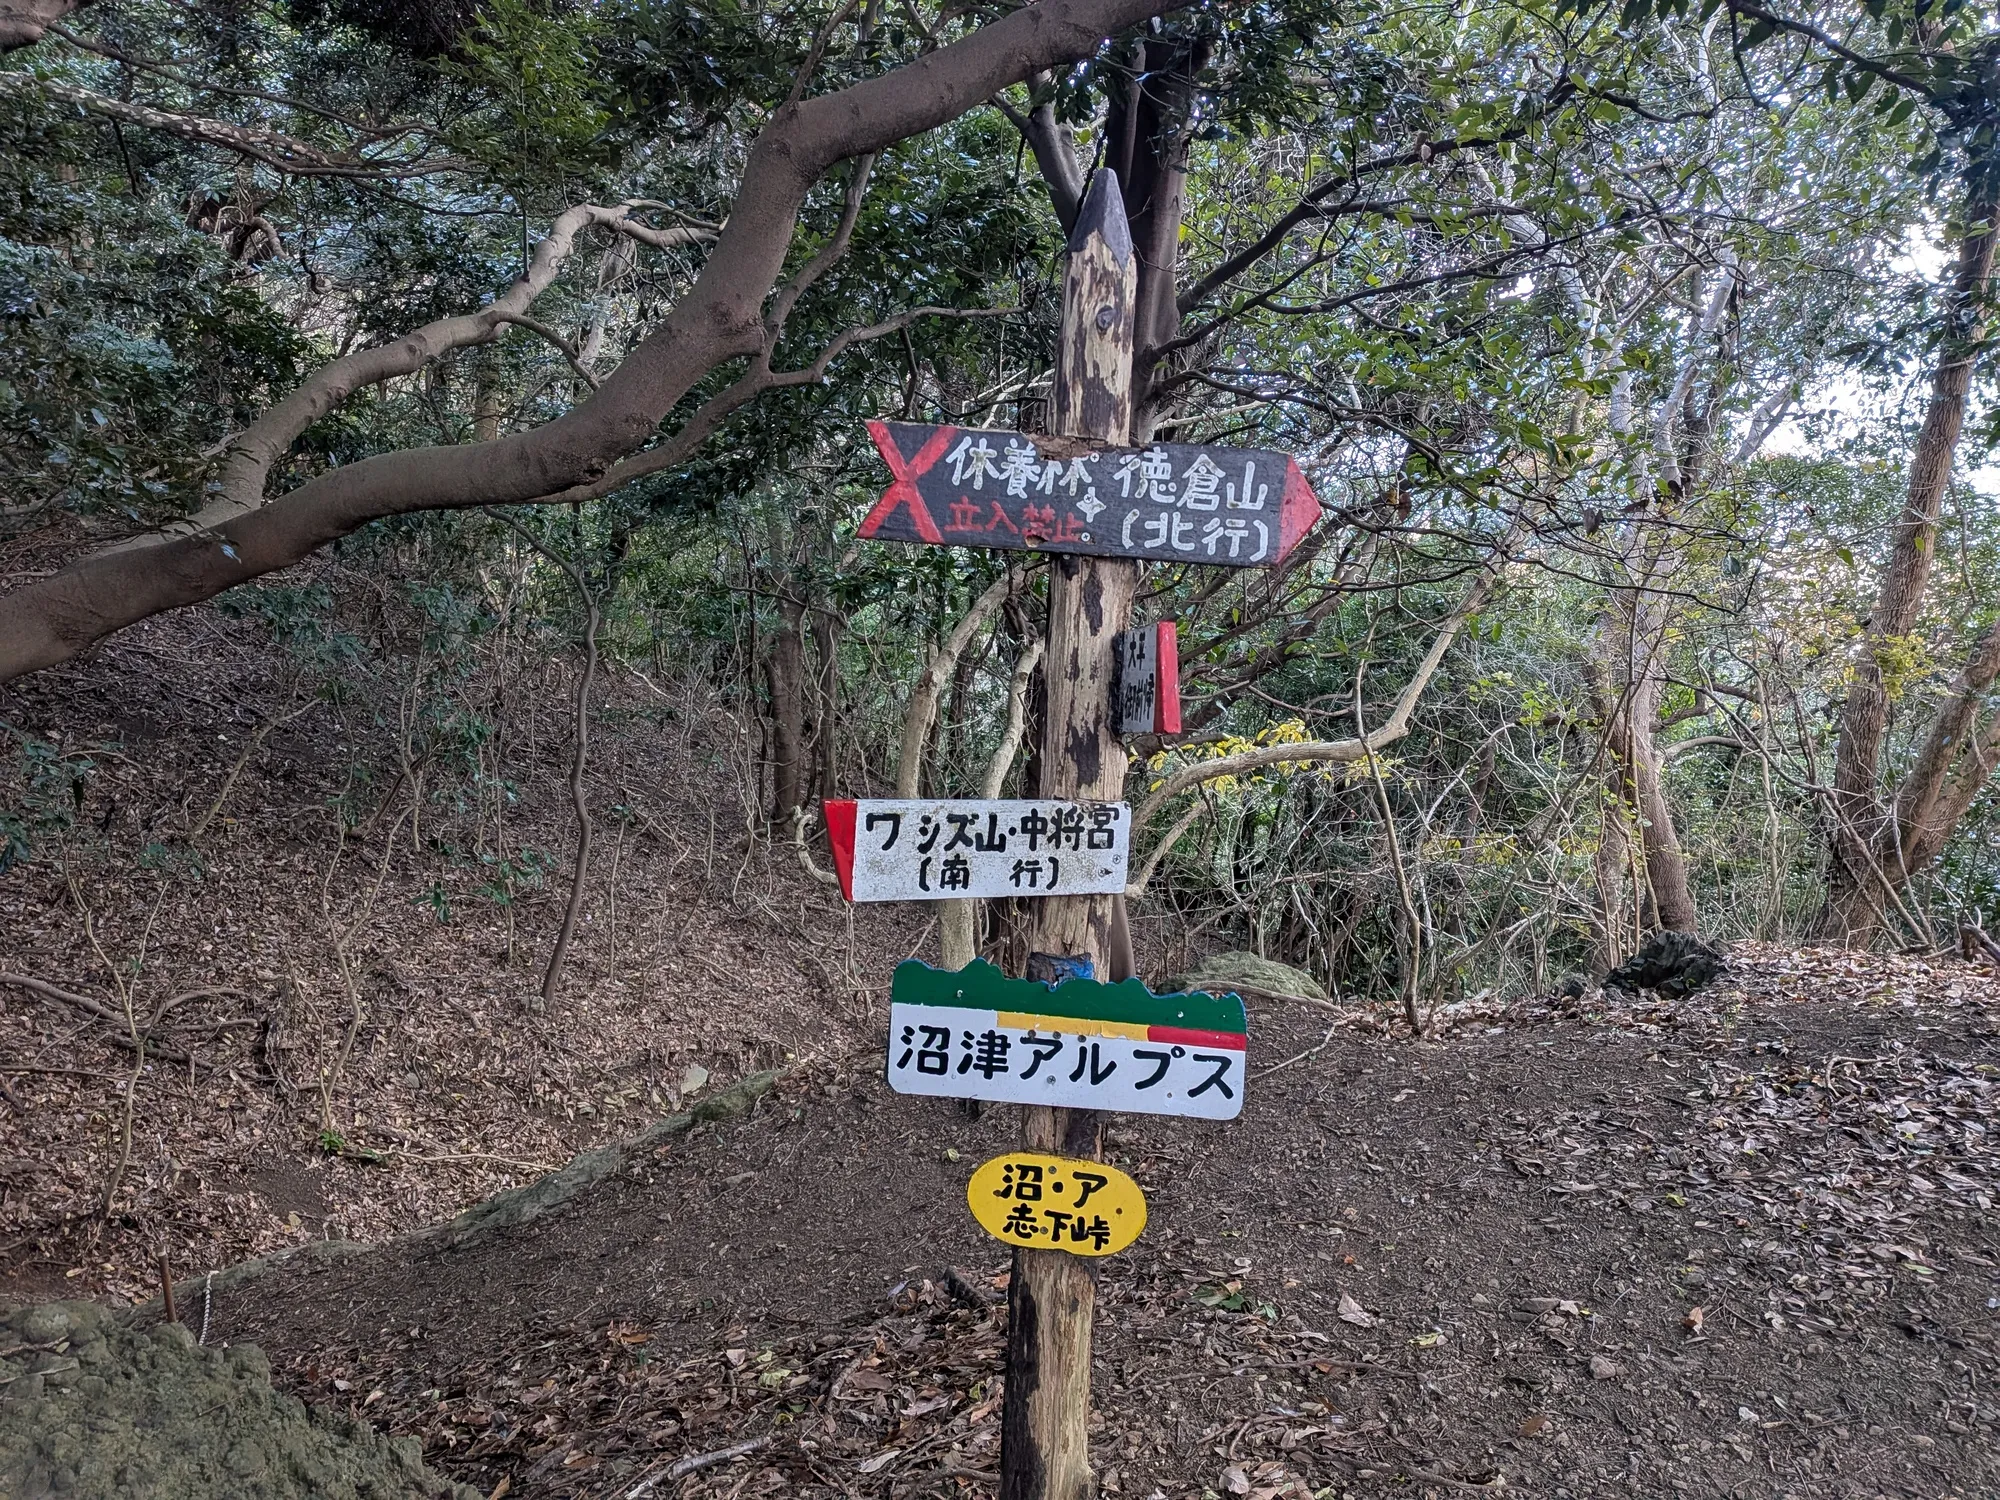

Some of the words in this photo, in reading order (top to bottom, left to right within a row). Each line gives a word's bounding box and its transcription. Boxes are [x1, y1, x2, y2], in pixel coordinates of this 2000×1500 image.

[1113, 446, 1268, 511] 徳倉山
[944, 495, 1085, 543] 立入禁止
[896, 1024, 1236, 1100] 沼津アルプス
[1002, 1202, 1111, 1252] 志下峠
